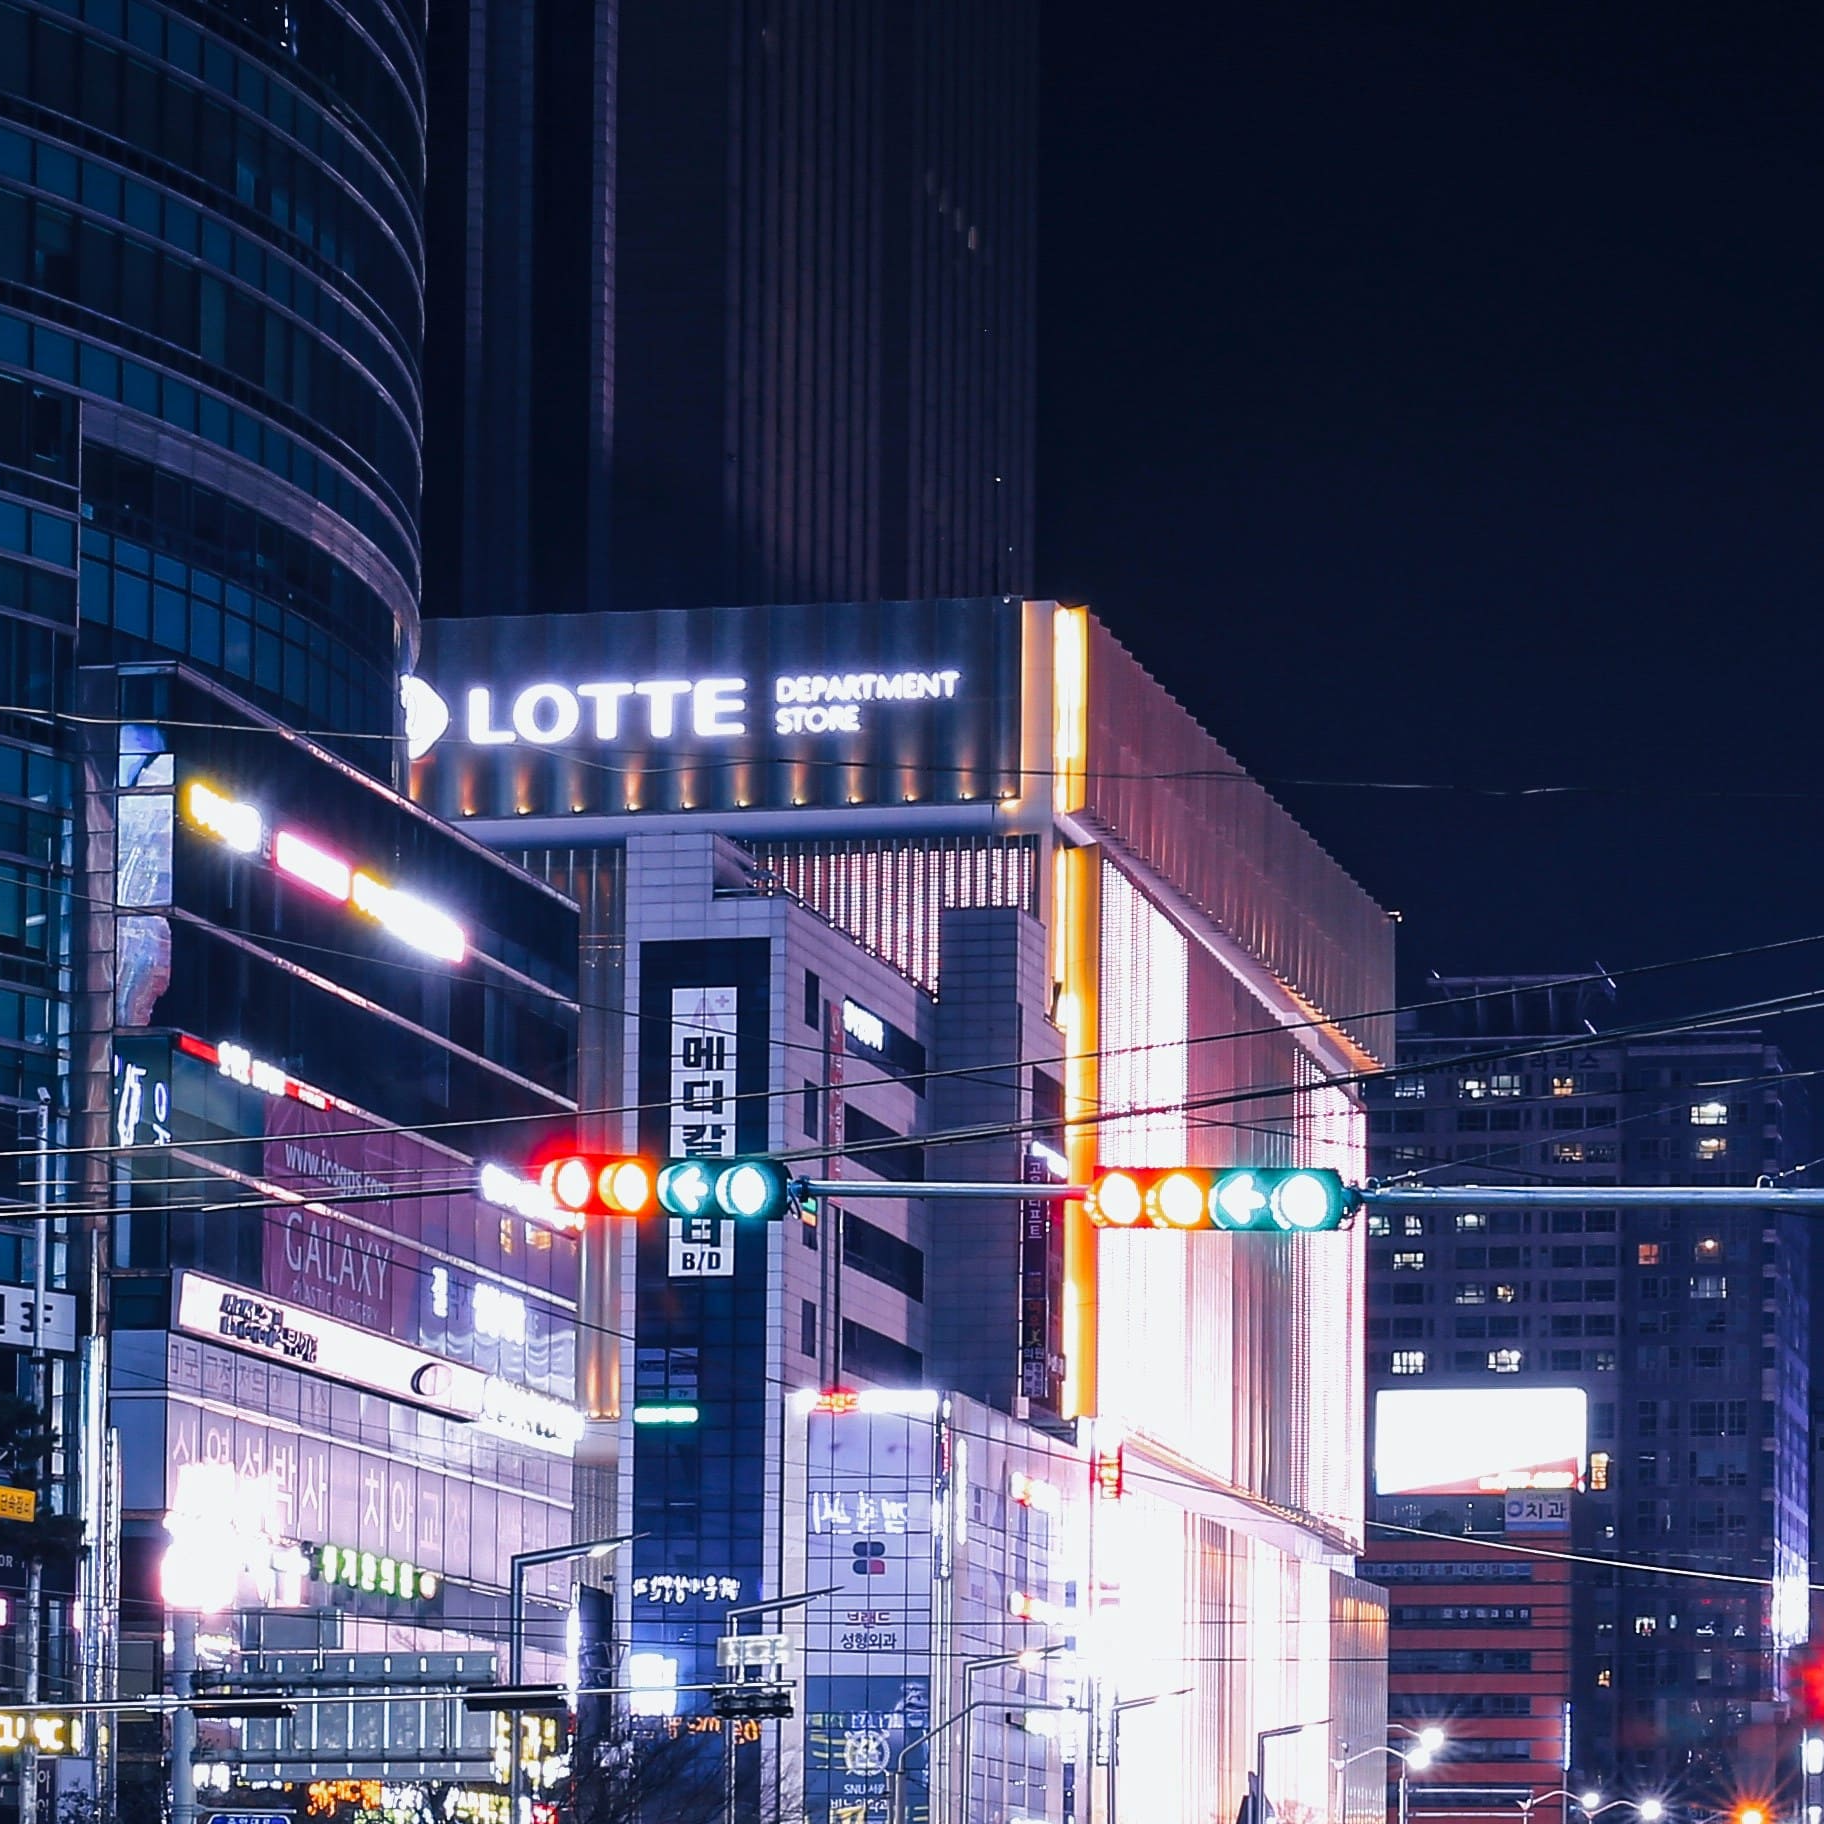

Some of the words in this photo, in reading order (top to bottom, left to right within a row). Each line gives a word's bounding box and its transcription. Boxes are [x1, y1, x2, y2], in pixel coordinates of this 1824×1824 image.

[776, 670, 959, 703] DEPARTMENT
[468, 678, 746, 744] LOTTE
[776, 704, 861, 735] STORE
[680, 1036, 727, 1247] 메디칼터
[285, 1211, 390, 1300] GALAXY
[682, 1252, 722, 1281] B/D
[292, 1280, 332, 1317] PLASTIC
[1525, 1503, 1567, 1519] 치과
[847, 1611, 890, 1629] 브랜드
[839, 1632, 897, 1650] 성형외과
[843, 1784, 866, 1796] SNU
